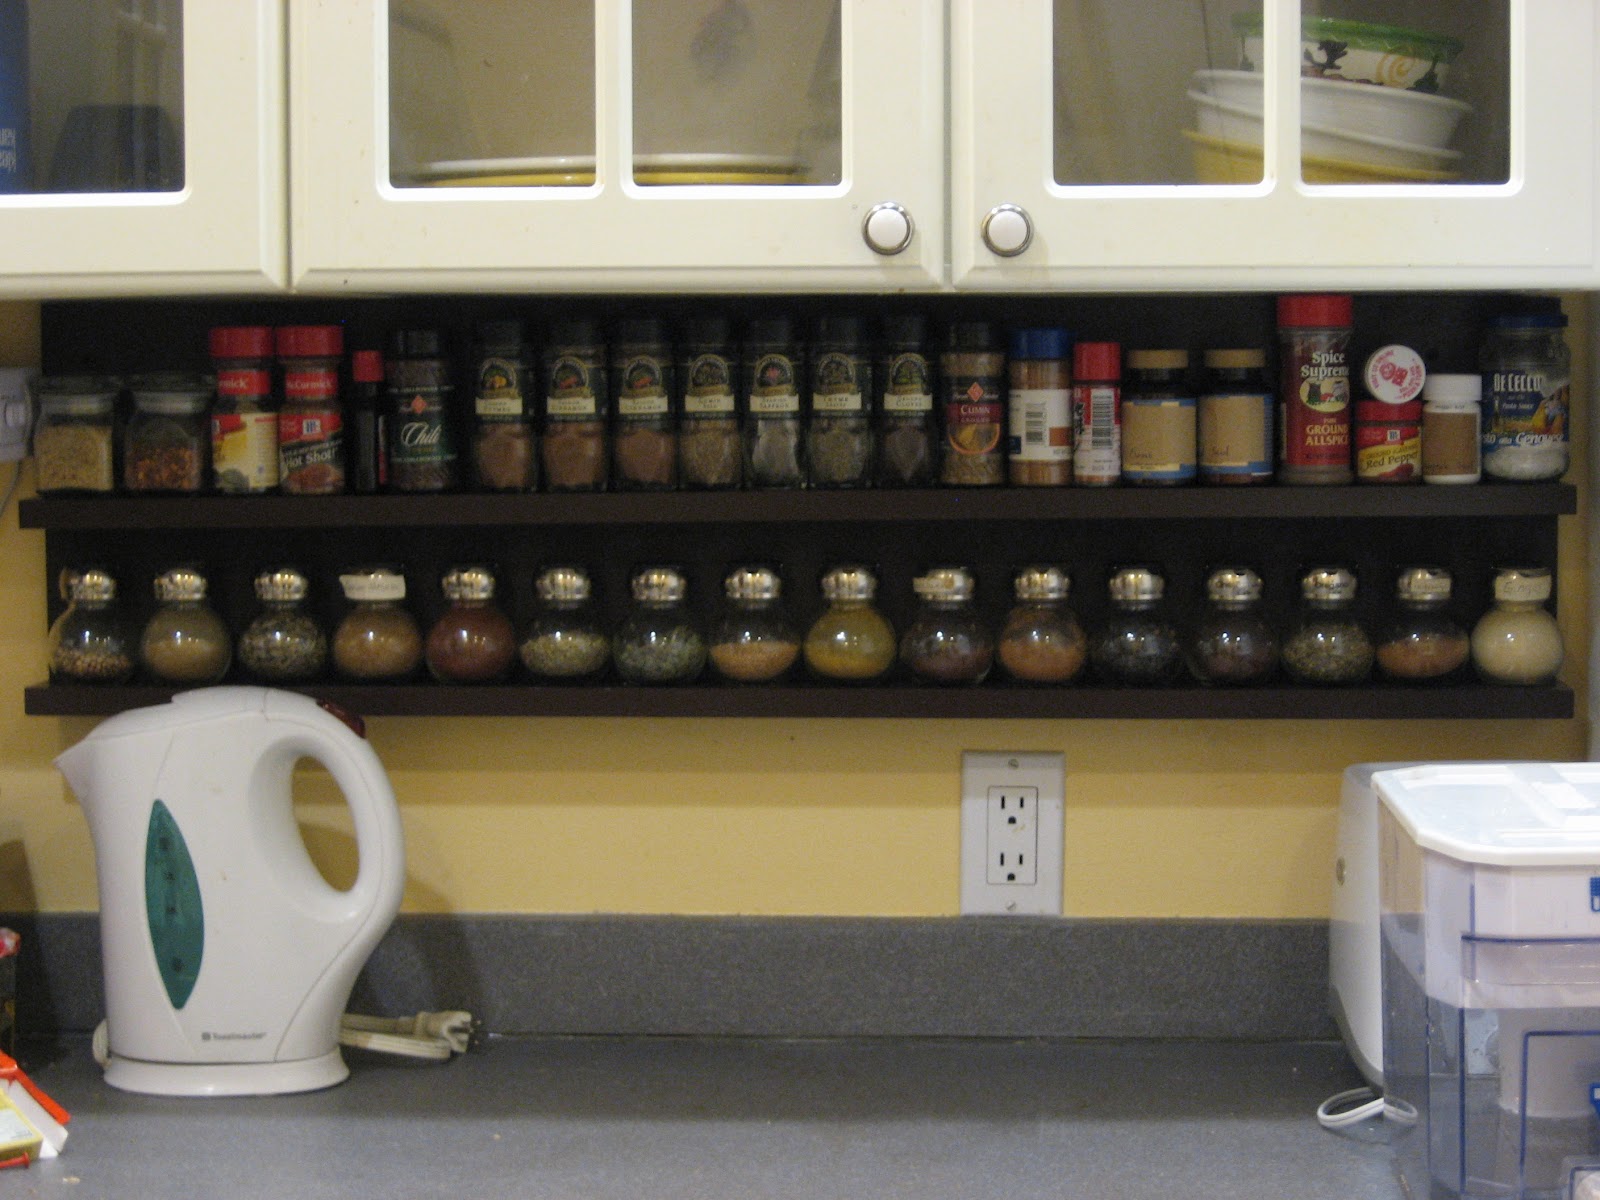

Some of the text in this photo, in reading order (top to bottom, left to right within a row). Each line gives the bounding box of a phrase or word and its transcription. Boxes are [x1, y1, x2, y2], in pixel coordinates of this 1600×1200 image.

[1311, 350, 1346, 367] Spice
[401, 421, 442, 447] Chili
[1366, 450, 1418, 470] Red Pepper
